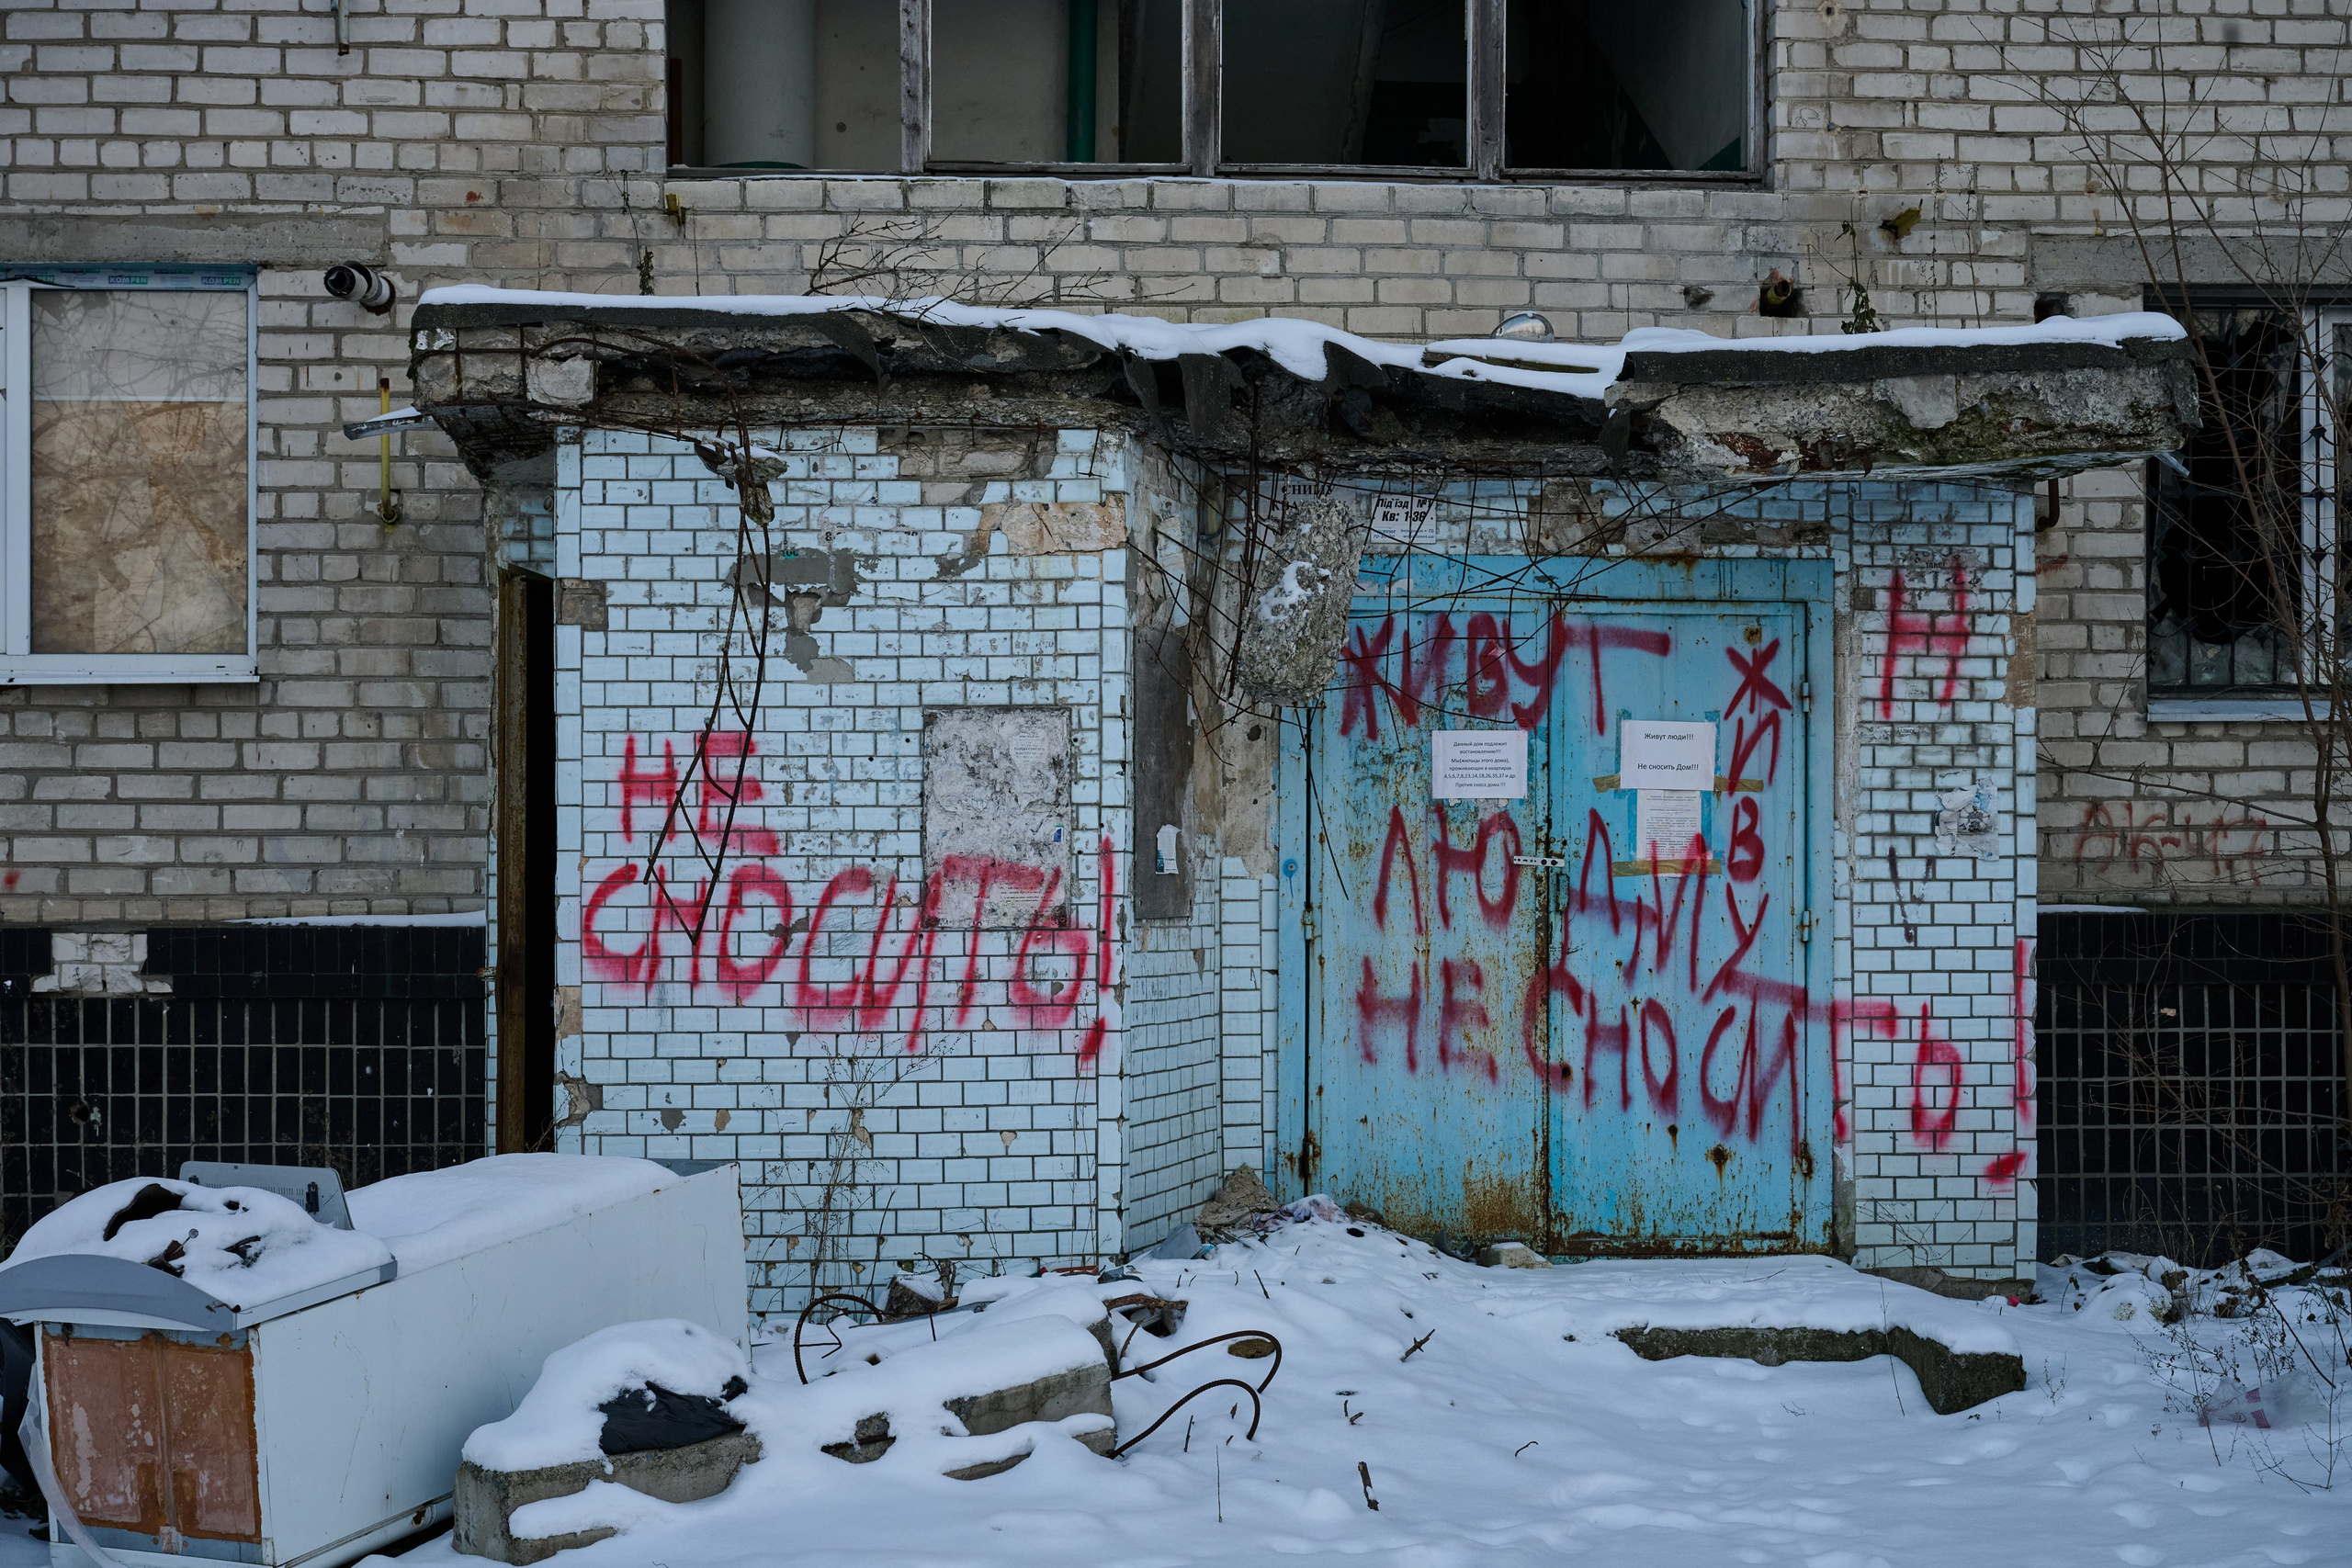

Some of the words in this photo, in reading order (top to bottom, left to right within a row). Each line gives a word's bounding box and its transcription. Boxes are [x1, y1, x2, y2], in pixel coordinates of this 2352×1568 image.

[1382, 511, 1400, 522] Кв:
[1340, 612, 1673, 742] ЖИВУТ
[619, 729, 782, 855] НЕ
[1357, 953, 1499, 1089] НЕ
